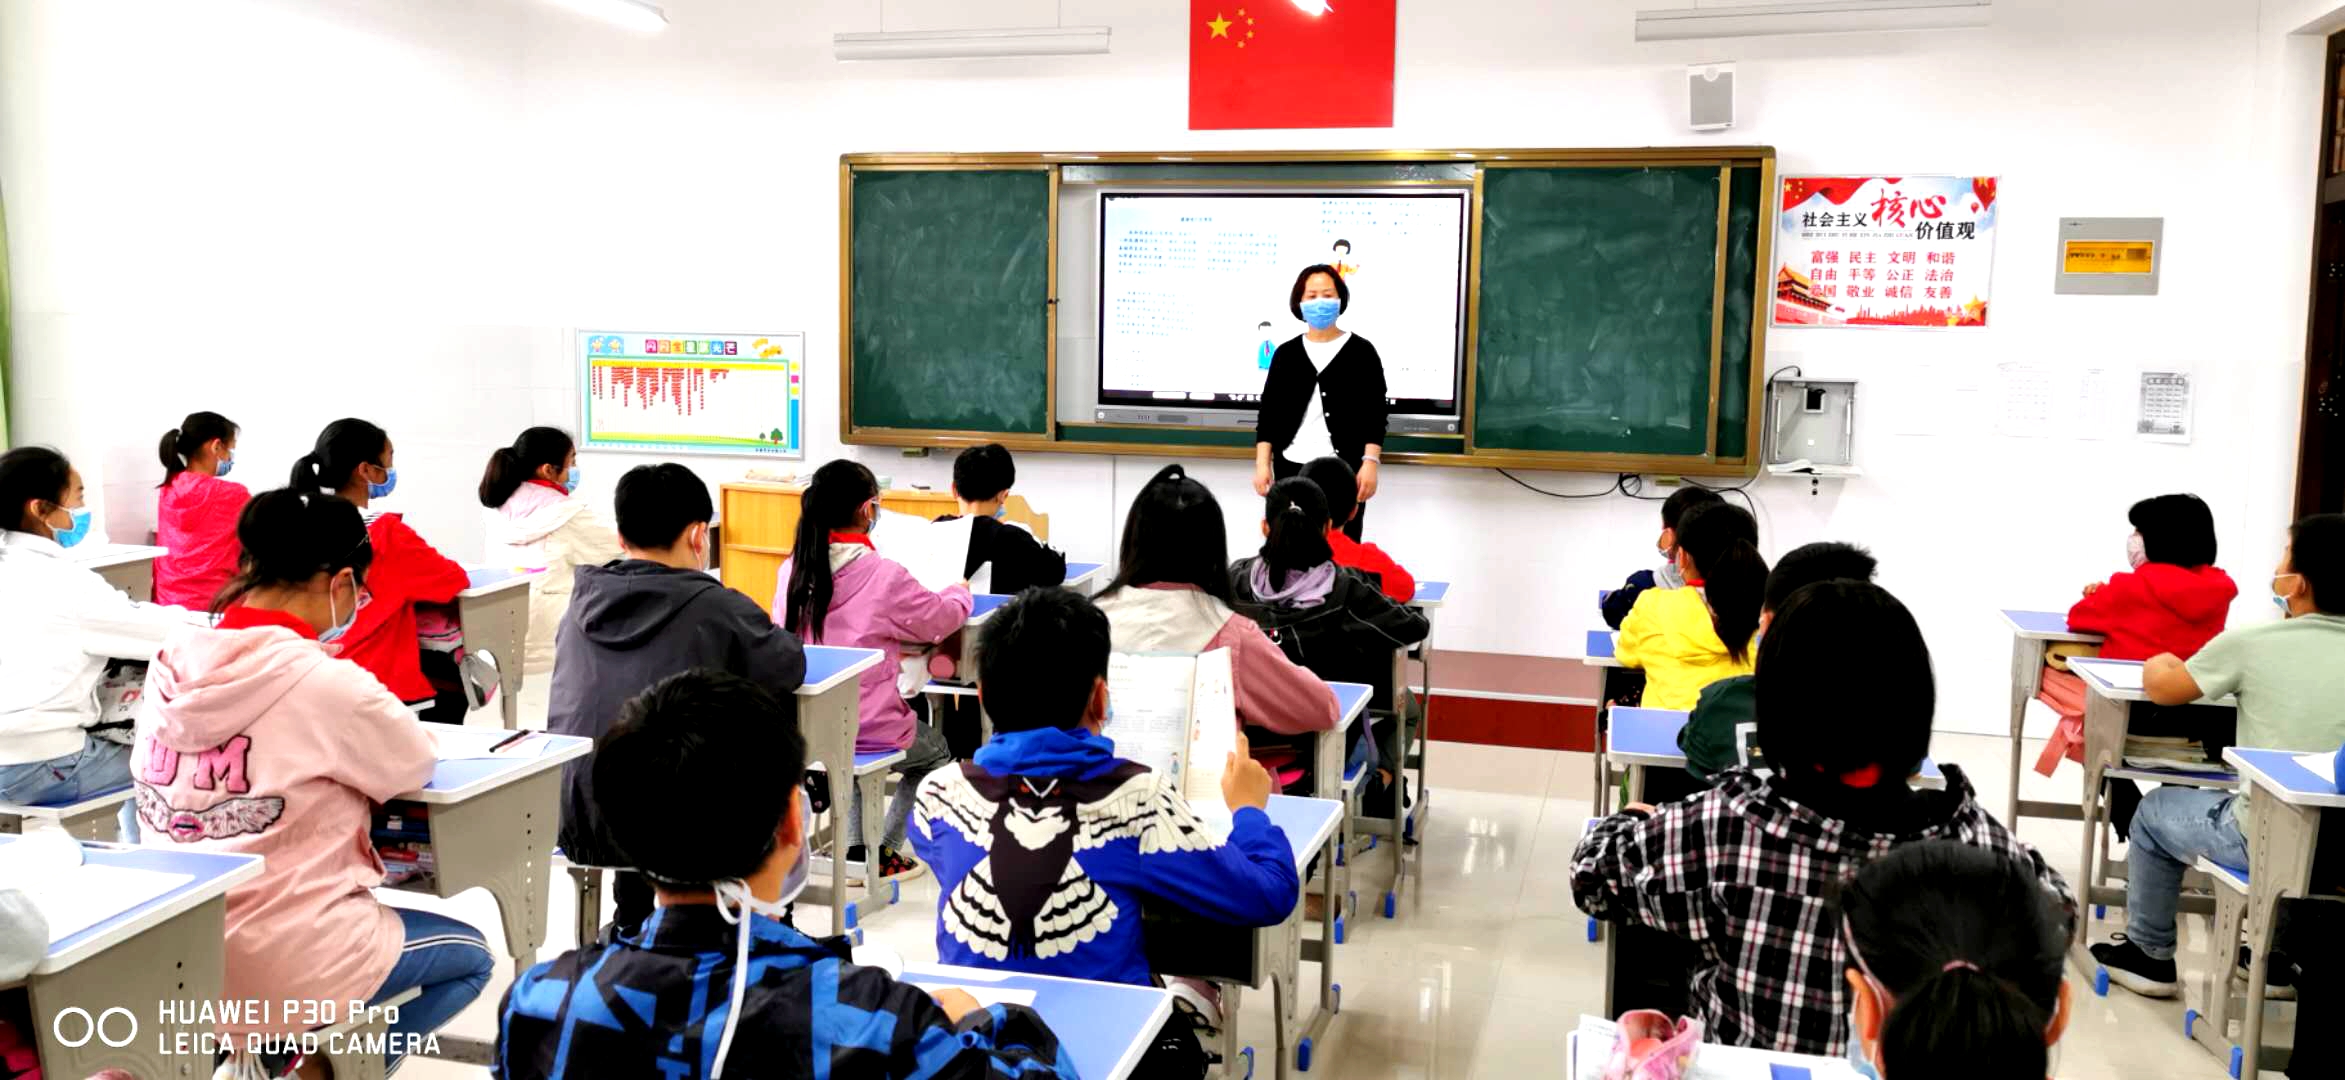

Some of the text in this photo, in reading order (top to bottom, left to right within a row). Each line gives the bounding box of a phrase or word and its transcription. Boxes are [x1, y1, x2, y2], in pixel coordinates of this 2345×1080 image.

[1871, 188, 1947, 228] 核心
[1802, 211, 1868, 228] 社会主义
[1915, 221, 1976, 240] 价值观
[1811, 251, 1956, 265] 富强 民主 文明 和谐
[1810, 268, 1954, 282] 自由 平等 公正 法治
[1846, 285, 1874, 298] 敬业
[1884, 286, 1913, 299] 诚信
[1923, 286, 1953, 299] 友善
